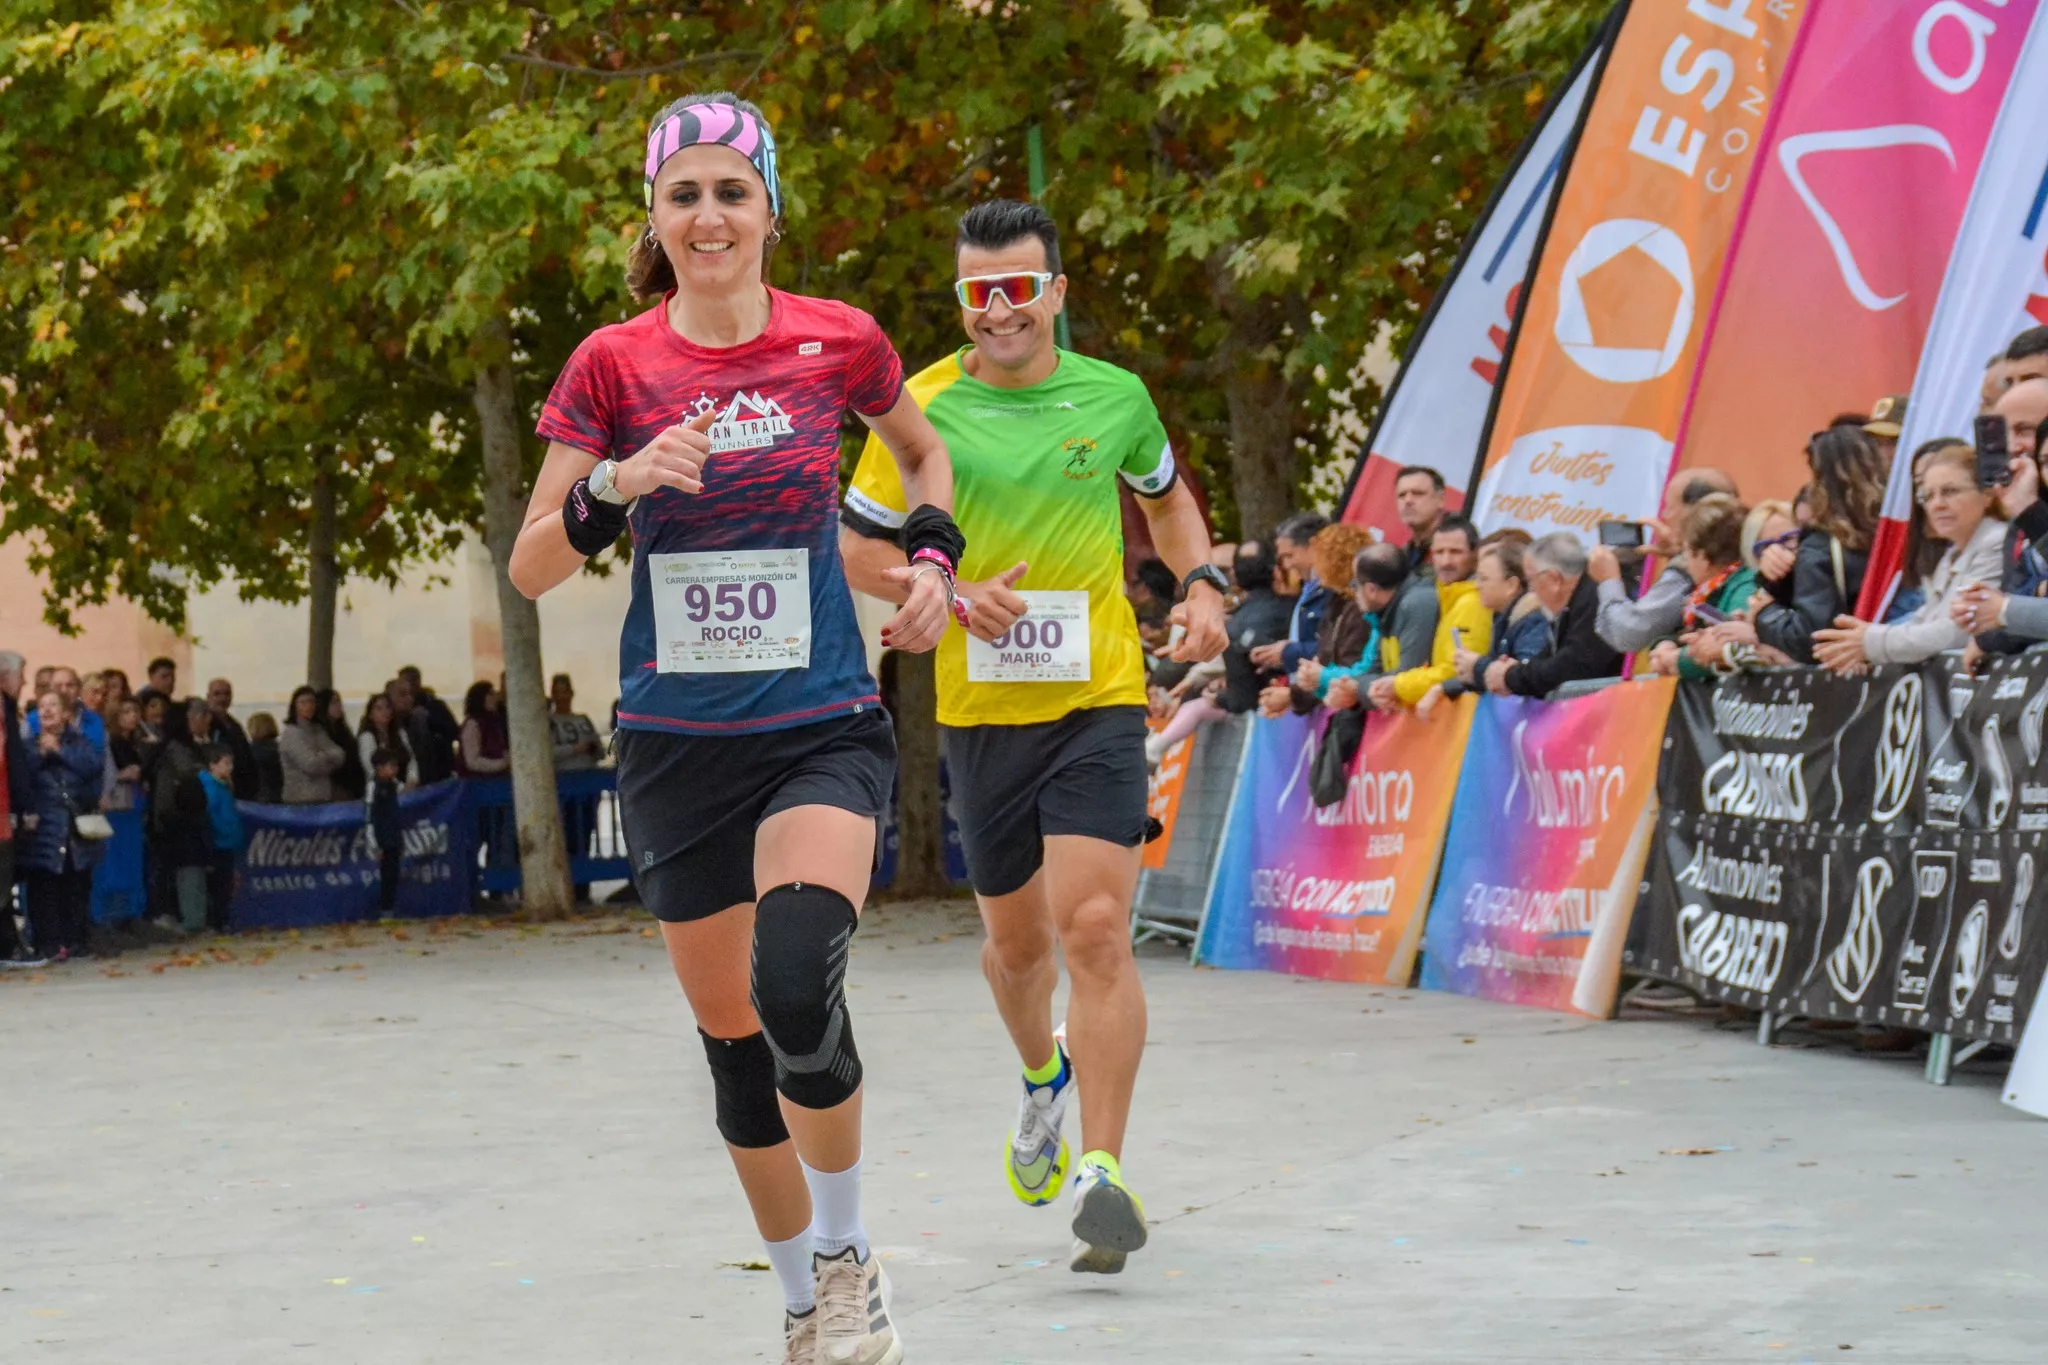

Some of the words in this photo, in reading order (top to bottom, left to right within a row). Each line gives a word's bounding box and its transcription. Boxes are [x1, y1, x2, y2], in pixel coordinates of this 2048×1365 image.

[741, 418, 786, 436] TRAIL
[710, 436, 771, 451] RUNNERS
[665, 576, 701, 585] CARRERA
[701, 574, 747, 584] EMPRESAS
[748, 571, 783, 582] MONZÓN
[784, 572, 798, 581] CM
[684, 582, 777, 622] 950
[701, 625, 762, 641] ROCIO
[1000, 652, 1051, 664] MARIO
[248, 827, 347, 867] Nicolás
[1676, 903, 1789, 993] CABRERO
